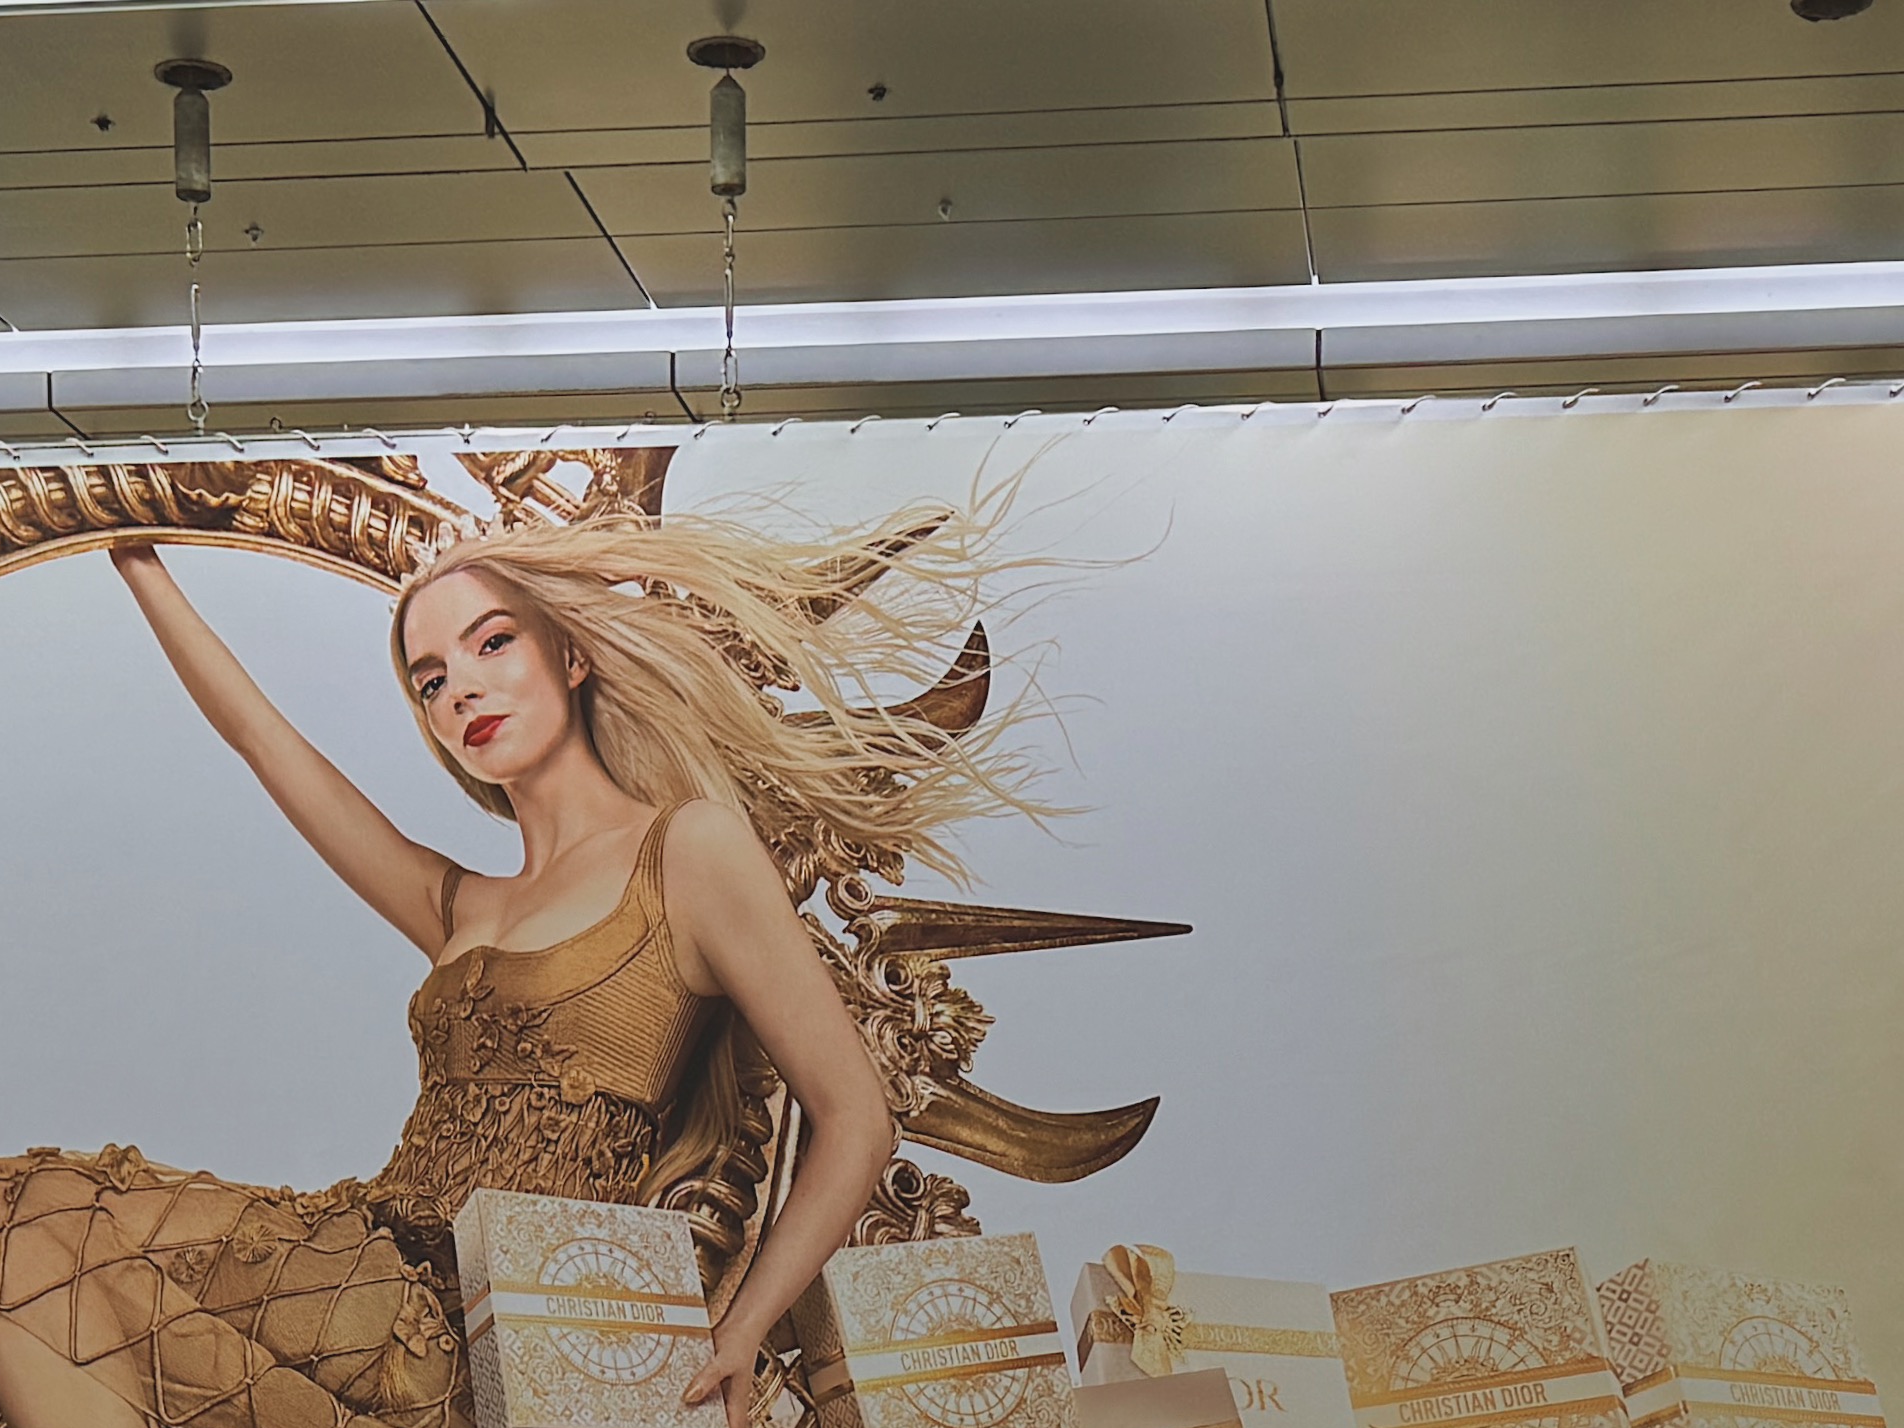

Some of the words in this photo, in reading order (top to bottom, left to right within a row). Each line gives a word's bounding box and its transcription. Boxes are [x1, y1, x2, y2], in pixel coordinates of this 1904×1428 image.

[546, 1297, 624, 1320] CHRISTIAN
[631, 1303, 665, 1323] DIOR
[900, 1345, 981, 1372] CHRISTIAN
[985, 1340, 1020, 1360] DIOR
[1229, 1376, 1288, 1412] OR
[1399, 1388, 1496, 1423] CHRISTIAN
[1501, 1382, 1548, 1408] DIOR
[1730, 1383, 1806, 1408] CHRISTIAN
[1810, 1390, 1842, 1411] DIOR
